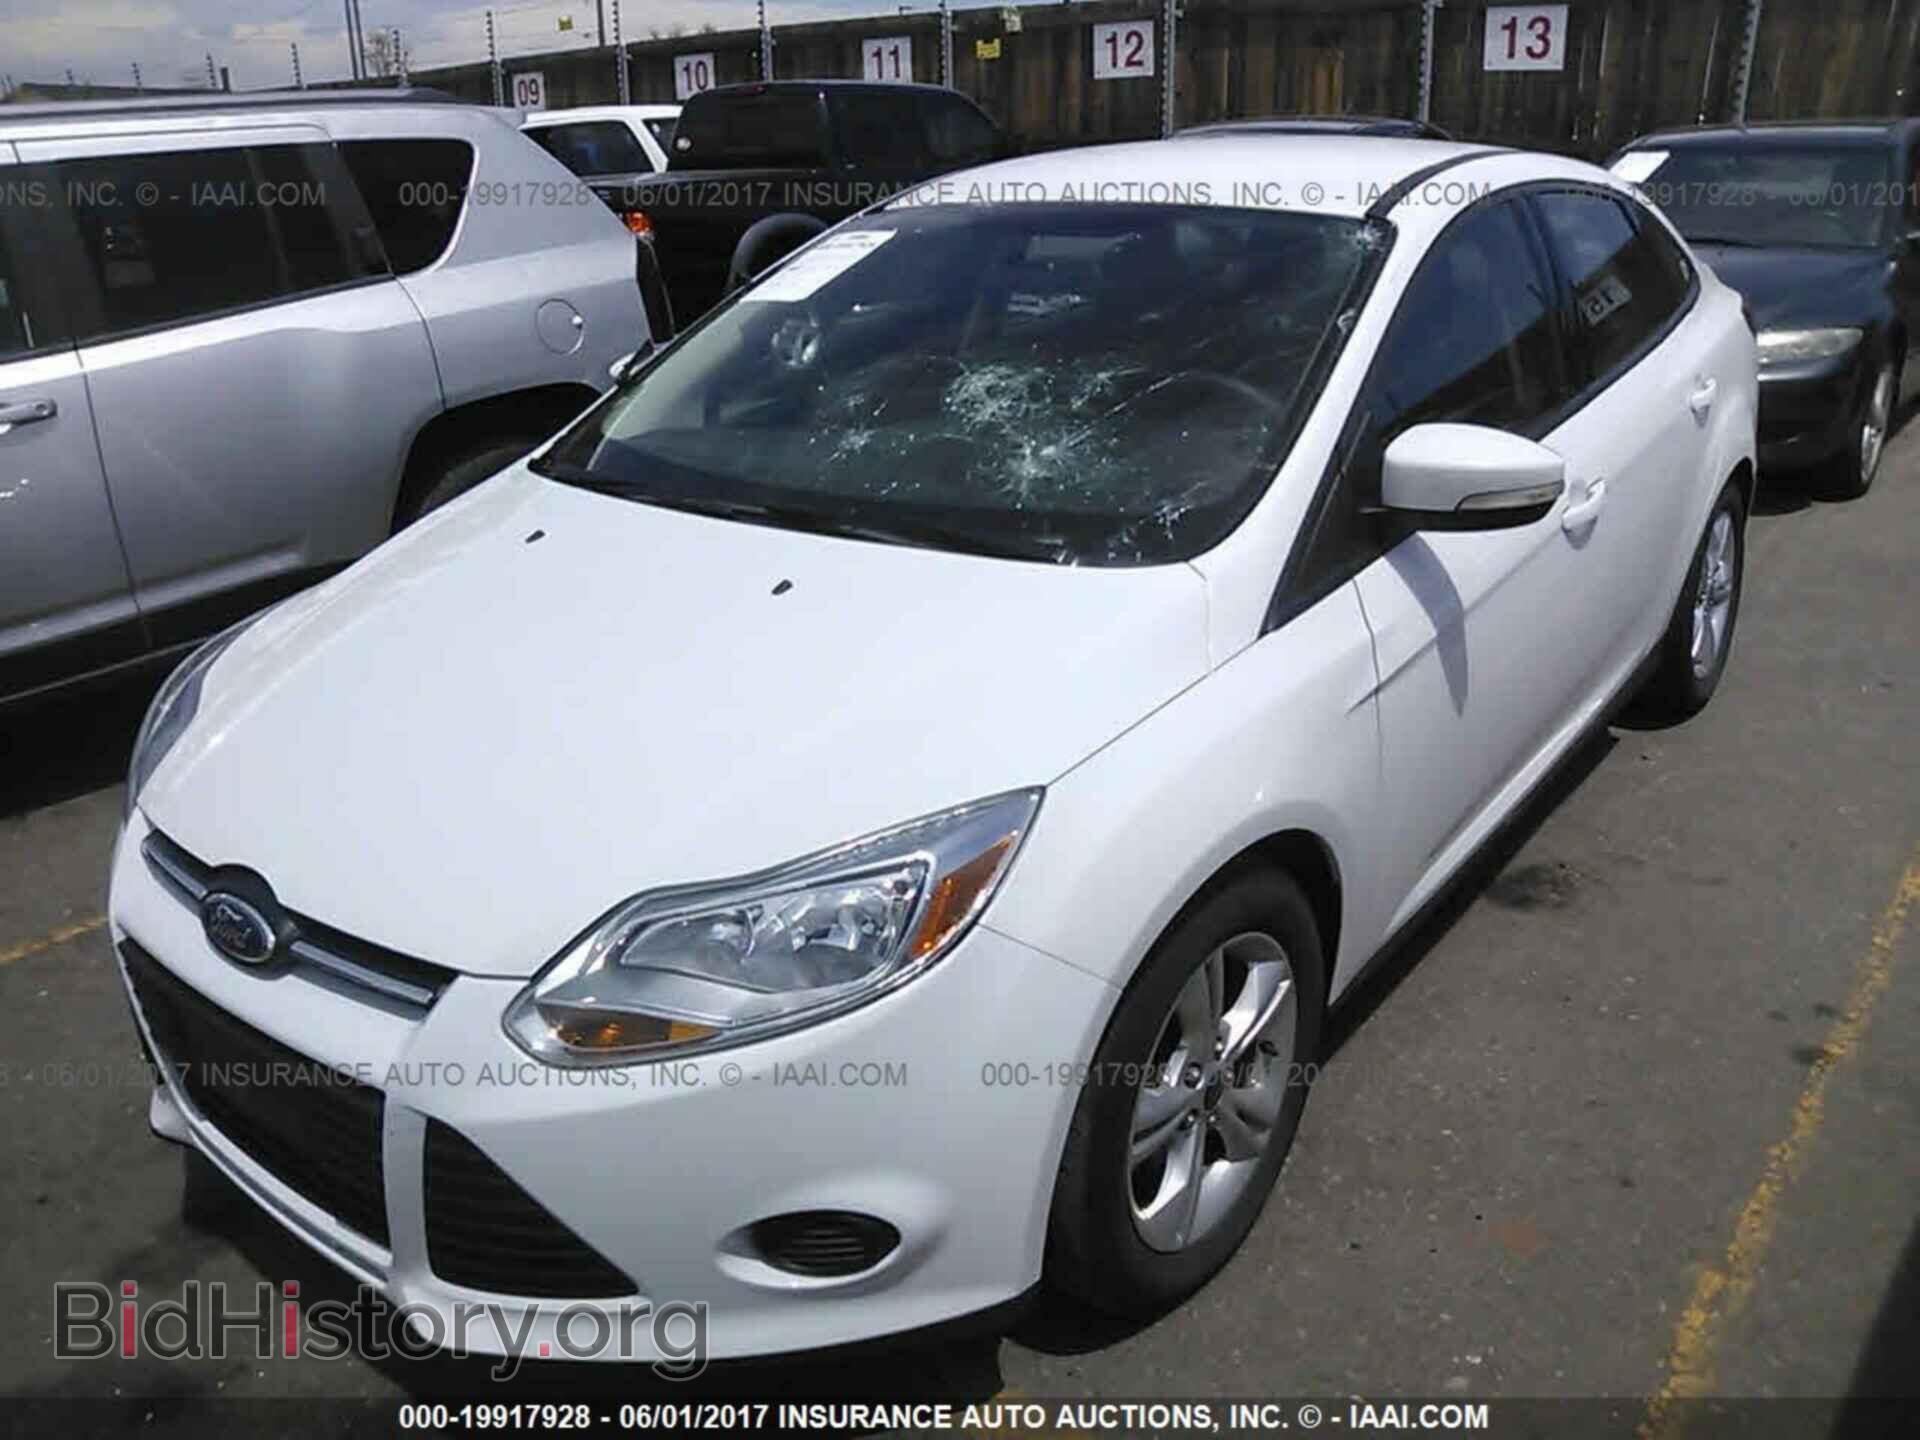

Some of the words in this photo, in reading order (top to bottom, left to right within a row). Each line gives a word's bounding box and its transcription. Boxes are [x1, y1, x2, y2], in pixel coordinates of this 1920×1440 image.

[1104, 30, 1146, 69] 12
[1501, 15, 1553, 60] 13
[681, 60, 710, 91] 10
[870, 46, 903, 80] 11
[516, 77, 541, 107] 09
